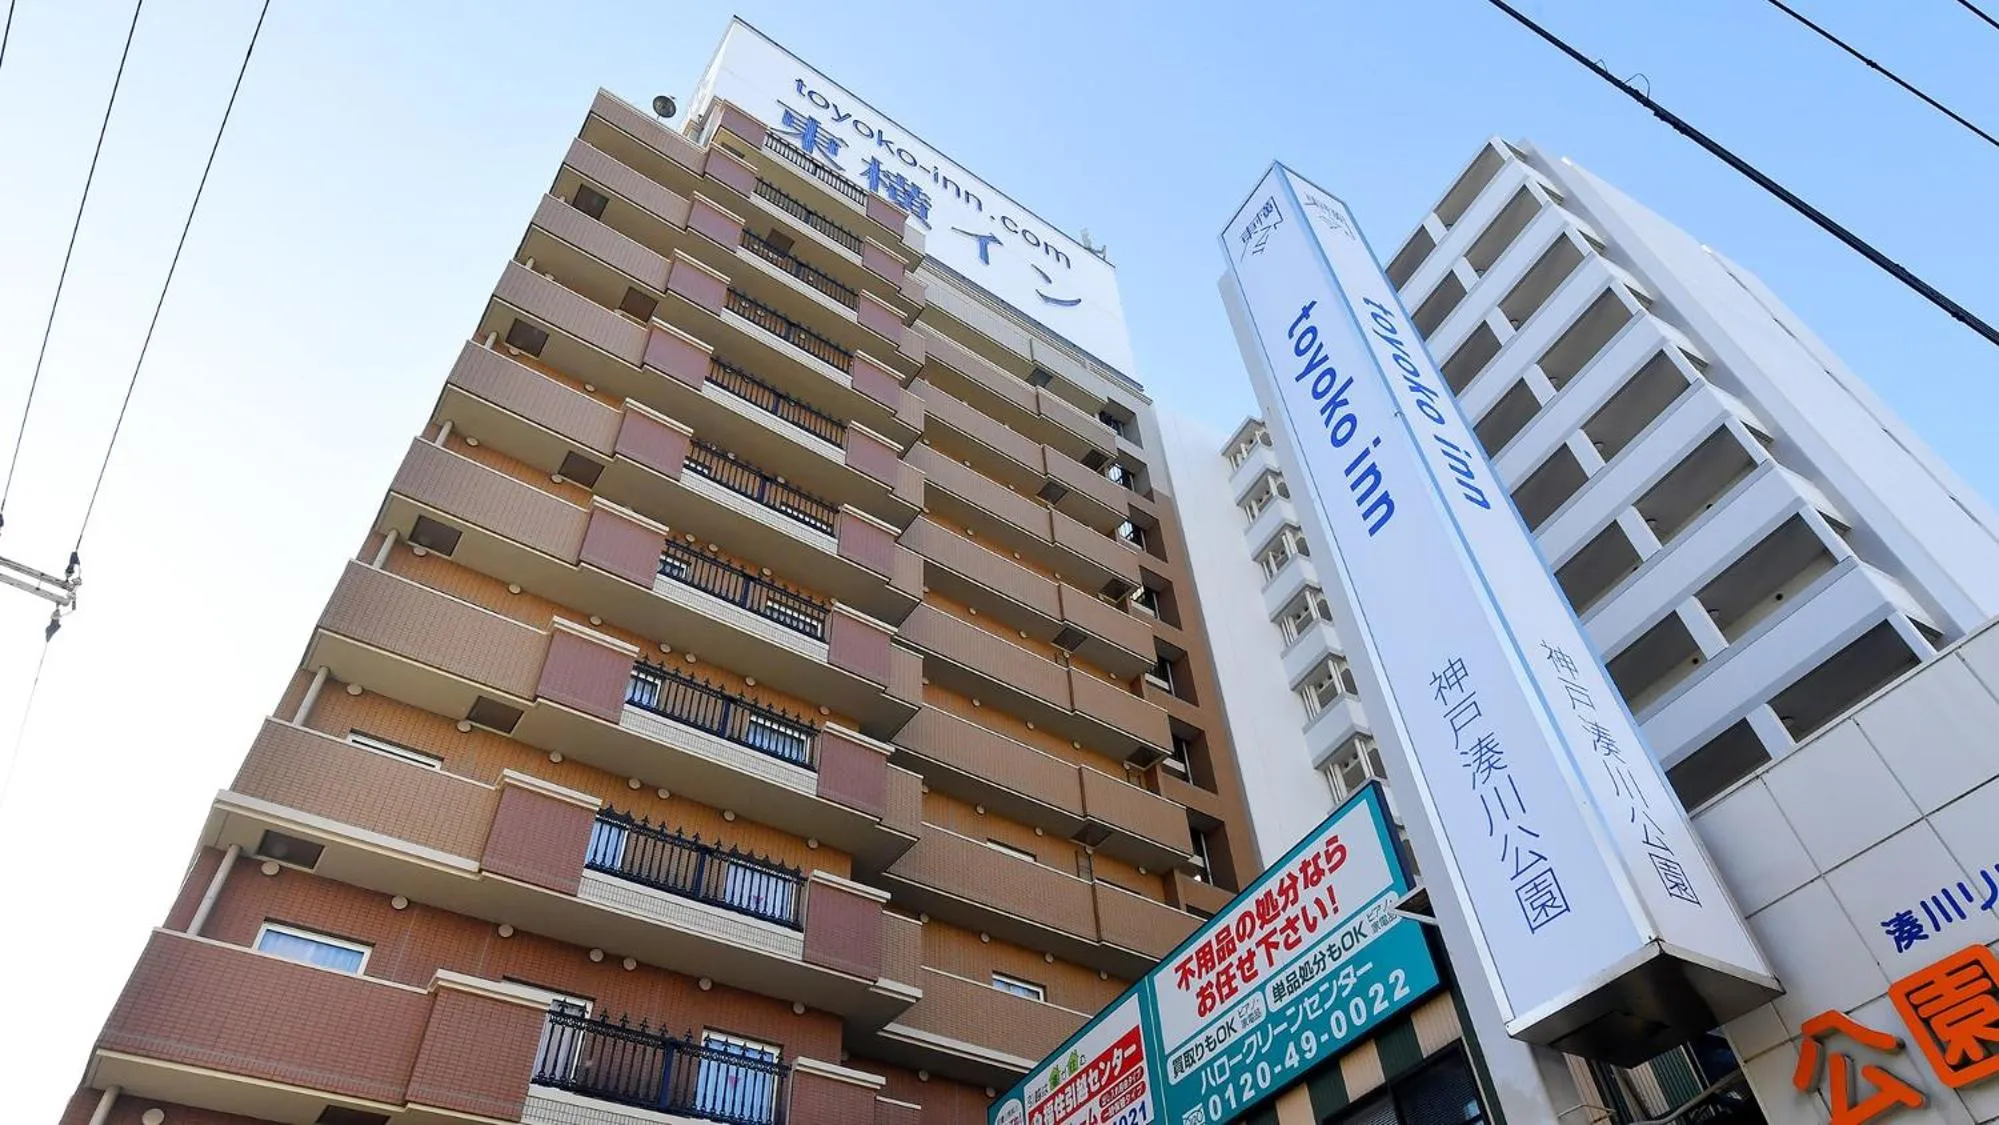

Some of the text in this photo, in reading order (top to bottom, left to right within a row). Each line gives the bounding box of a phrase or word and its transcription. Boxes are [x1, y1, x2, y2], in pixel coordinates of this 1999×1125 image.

[769, 99, 1081, 307] 東横イン
[795, 78, 1072, 269] toyoko-inn.com
[1287, 299, 1358, 449] toyoko
[1344, 436, 1396, 538] inn
[1363, 297, 1491, 510] toyoko inn
[1429, 657, 1570, 935] 神戸湊川公園
[1540, 639, 1702, 908] 神戸湊川公園
[1174, 835, 1347, 992] 不用品の処分なら
[1195, 885, 1339, 1017] お任せ下さい!
[1272, 921, 1368, 1003] 単品処分もOK
[1881, 863, 1999, 953] 湊川リ
[1172, 1017, 1238, 1079] 買取りもOK
[1201, 962, 1373, 1095] ハロークリーンセンター
[1209, 969, 1411, 1121] 0120-49-0022
[1793, 943, 1999, 1125] 公園
